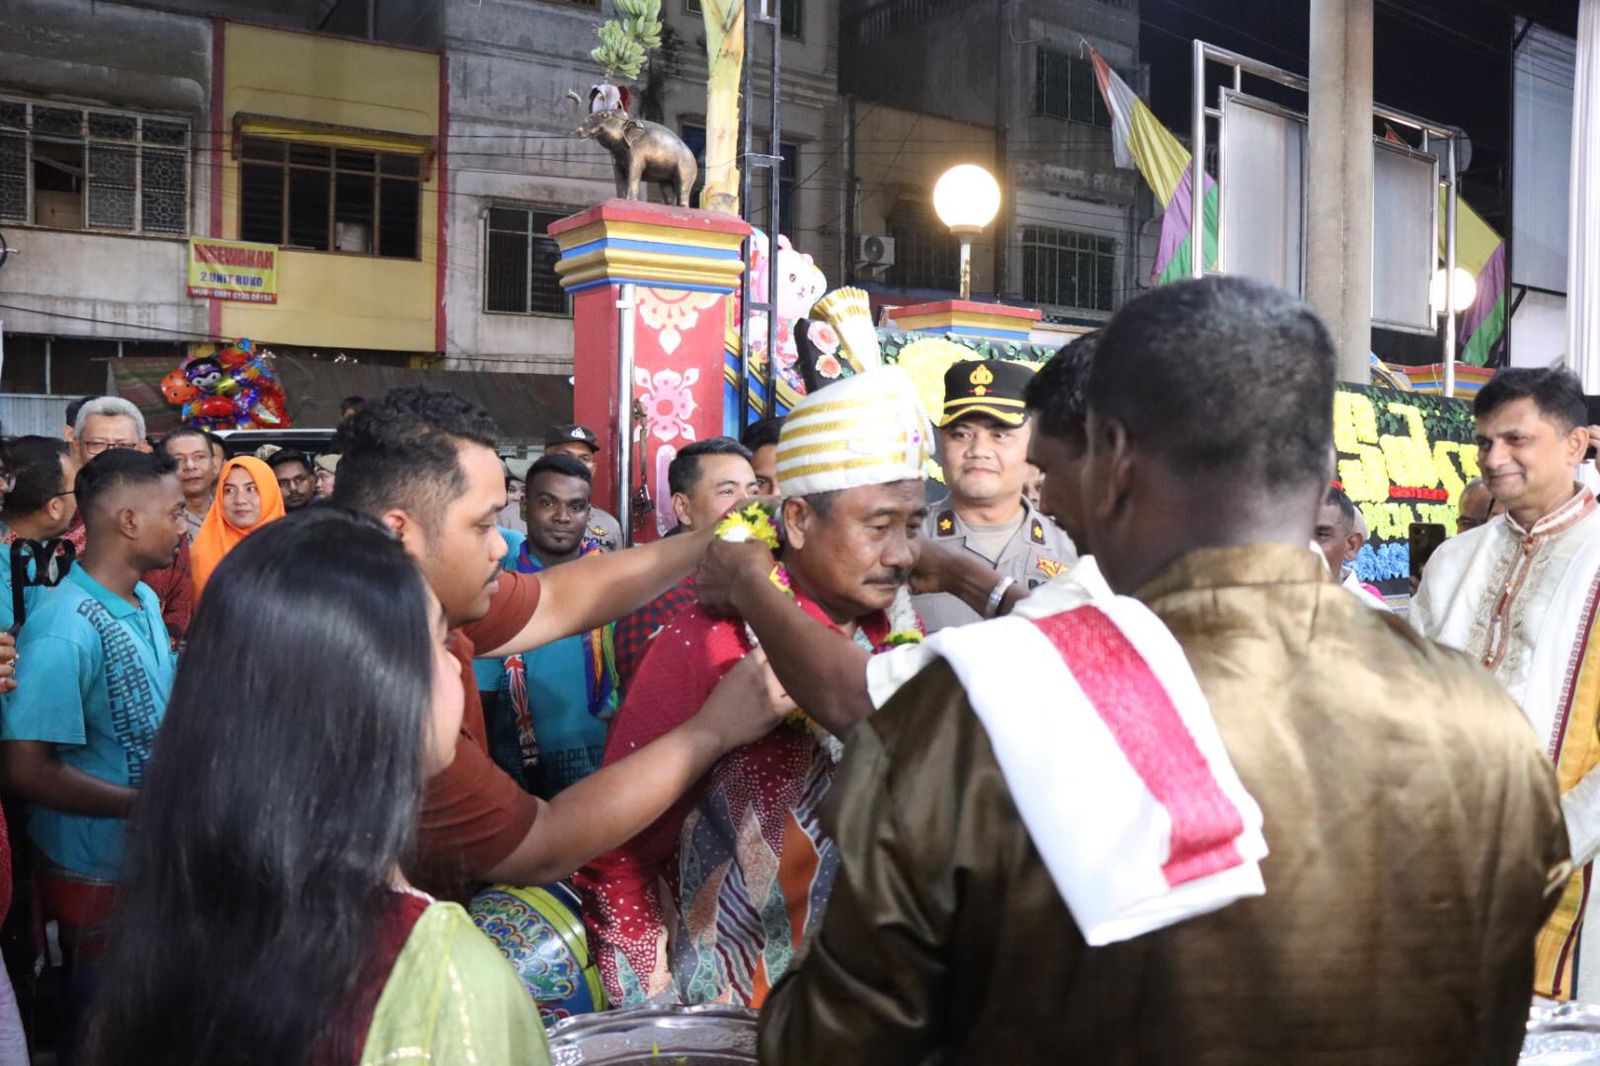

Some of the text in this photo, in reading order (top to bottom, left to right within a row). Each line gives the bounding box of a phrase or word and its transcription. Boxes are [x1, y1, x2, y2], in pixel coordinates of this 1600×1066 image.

[200, 271, 263, 287] 2 UNIT RUKO
